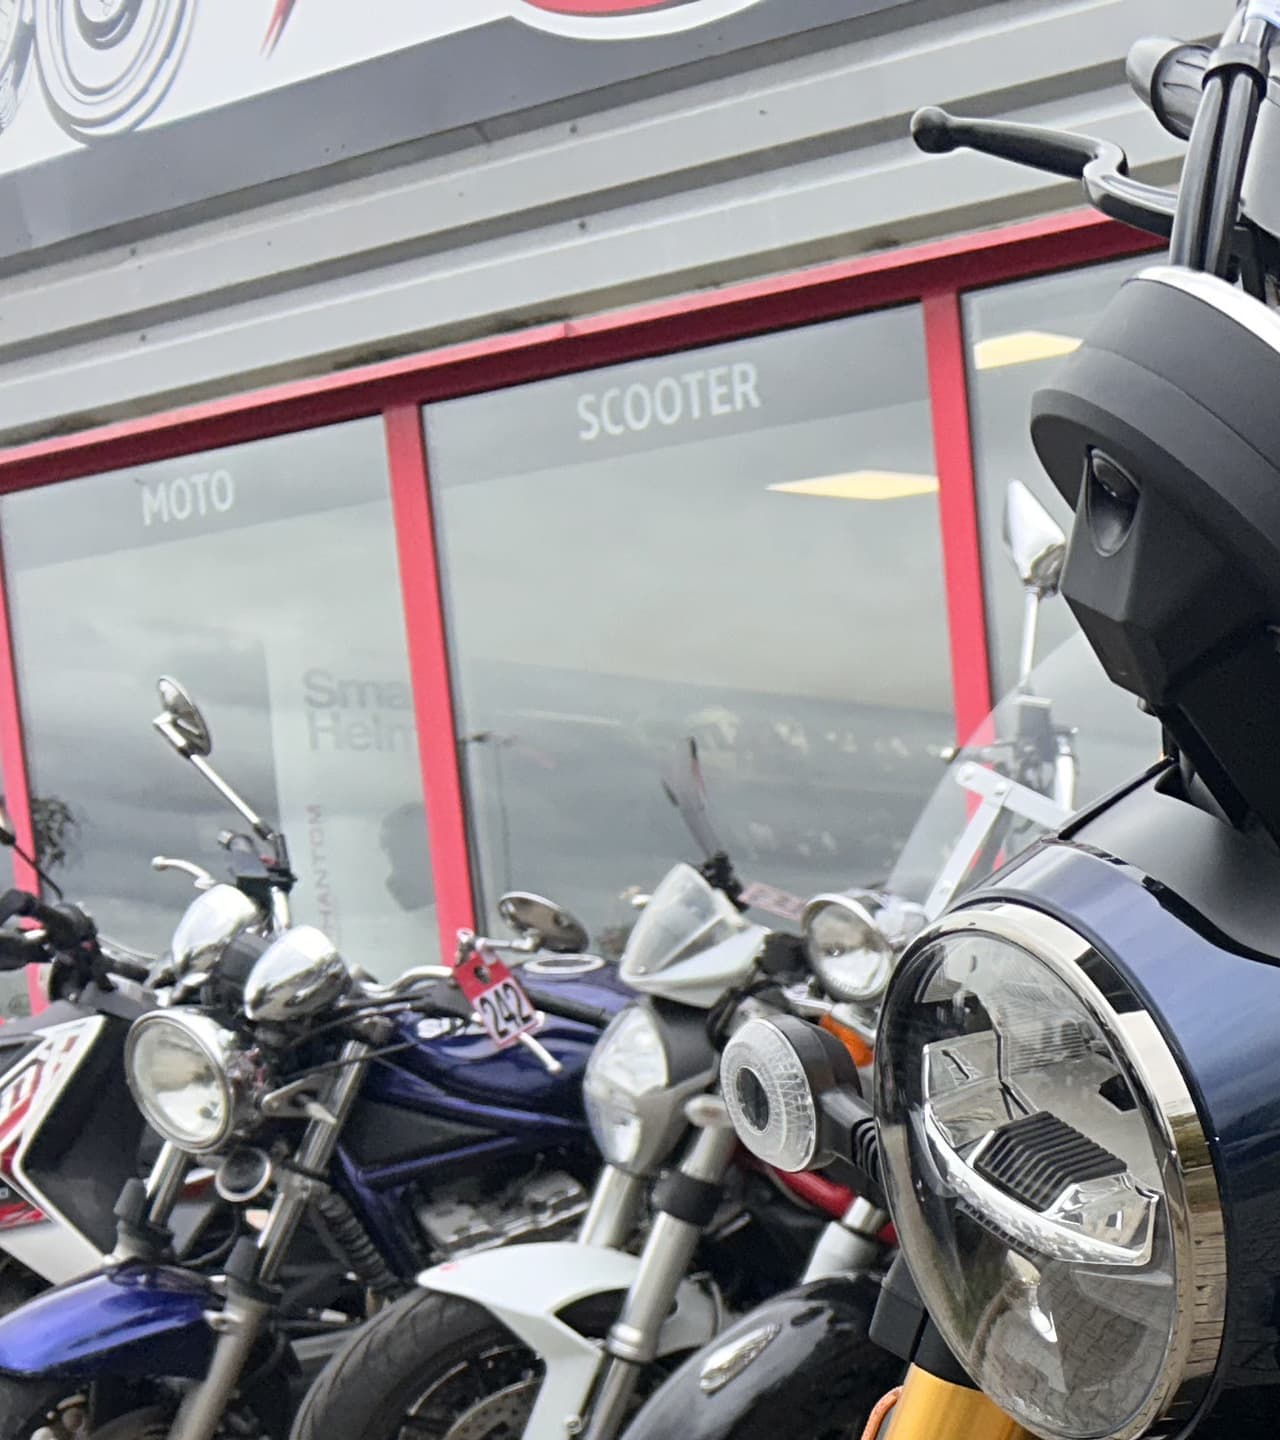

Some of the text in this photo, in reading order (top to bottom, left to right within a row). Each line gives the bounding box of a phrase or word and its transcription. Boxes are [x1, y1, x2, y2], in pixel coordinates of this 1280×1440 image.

[577, 362, 761, 441] SCOOTER
[142, 471, 233, 525] MOTO
[479, 982, 532, 1037] 242
